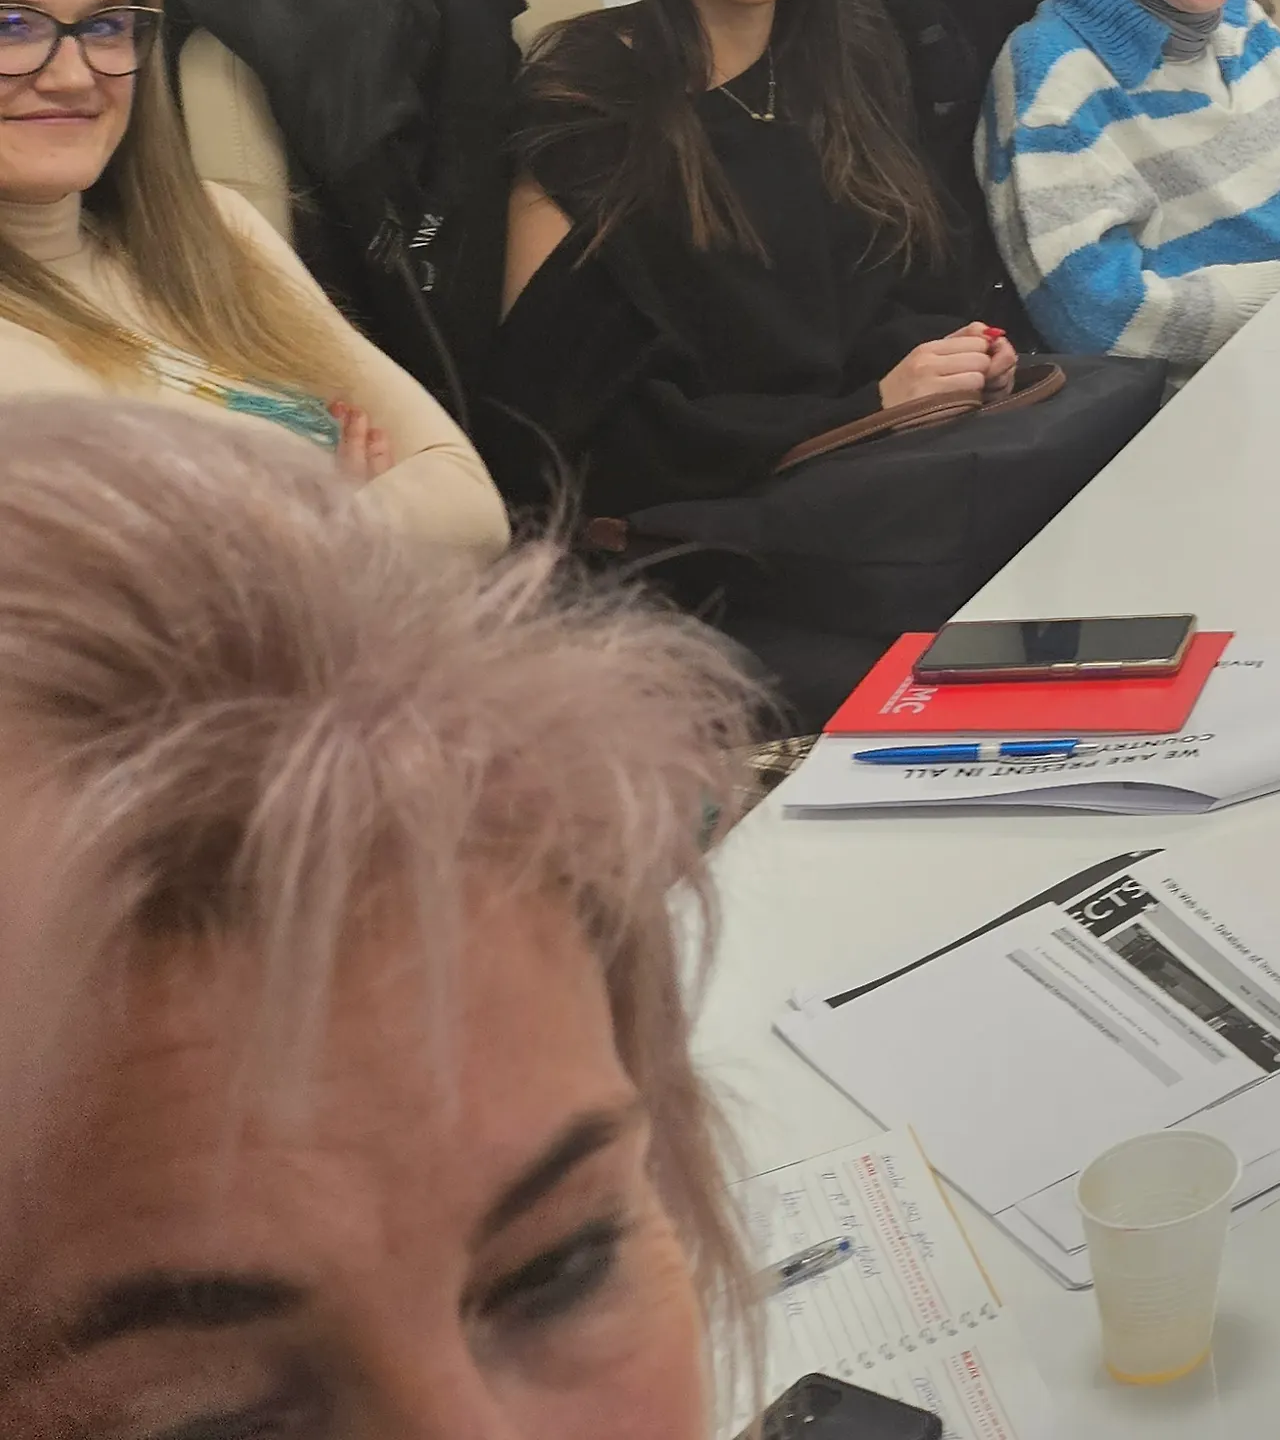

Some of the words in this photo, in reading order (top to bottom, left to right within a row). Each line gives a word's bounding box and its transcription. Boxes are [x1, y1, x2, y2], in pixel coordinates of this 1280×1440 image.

[1105, 752, 1158, 766] ARE
[1164, 747, 1201, 760] WE
[904, 767, 949, 779] ALL
[953, 767, 985, 778] IN
[989, 761, 1100, 777] PRESENT
